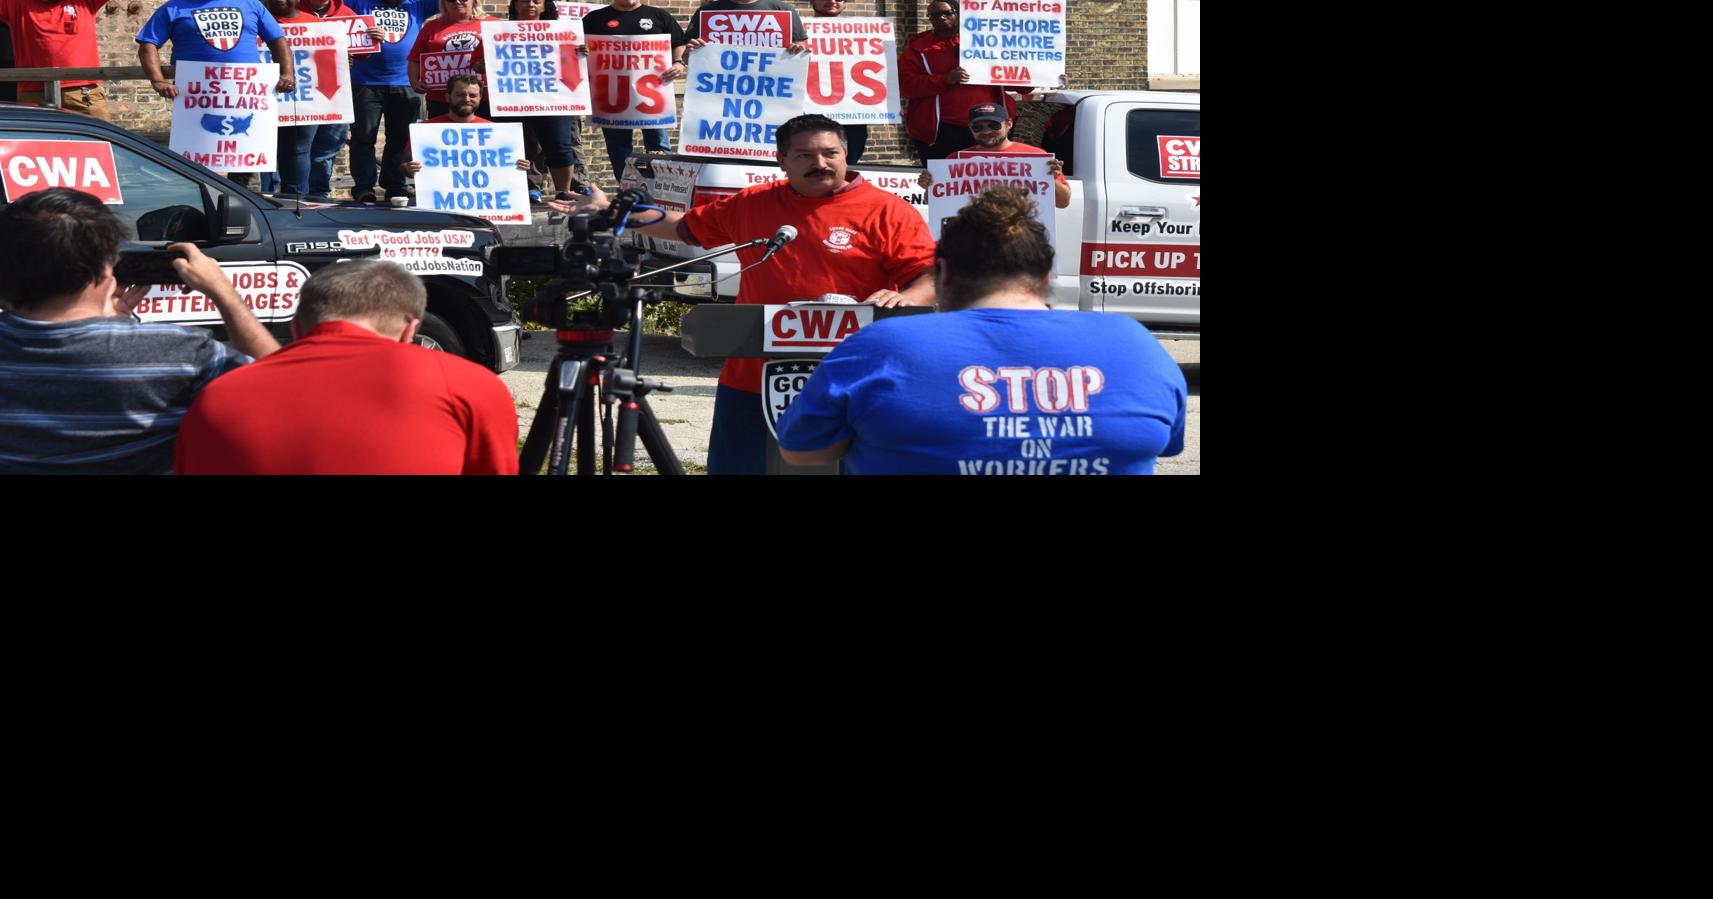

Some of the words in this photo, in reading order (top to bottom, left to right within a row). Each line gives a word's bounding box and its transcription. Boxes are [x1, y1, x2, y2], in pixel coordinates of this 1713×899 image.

[557, 5, 590, 17] EEP
[963, 0, 987, 10] for
[991, 0, 1061, 13] America
[198, 13, 238, 21] GOOD
[377, 18, 406, 27] JOBS
[708, 14, 782, 31] CWA
[964, 16, 1060, 33] OFFSHORE
[203, 21, 239, 31] JOBS
[282, 26, 308, 36] TOP
[517, 22, 550, 32] STOP
[803, 22, 891, 34] FFSHORING
[493, 32, 577, 42] OFFSHORING
[708, 31, 783, 48] STRONG
[972, 34, 998, 47] NO
[1002, 35, 1055, 49] MORE
[495, 44, 555, 60] KEEP
[590, 40, 670, 52] OFFSHORING
[807, 37, 885, 55] HURTS
[596, 54, 667, 71] HURTS
[720, 50, 776, 73] OFF
[963, 49, 998, 59] CALL
[1000, 50, 1062, 61] CENTERS
[205, 66, 257, 80] KEEP
[495, 61, 556, 76] JOBS
[990, 65, 1031, 81] CWA
[188, 81, 228, 94] U.S.
[236, 82, 268, 96] TAX
[497, 77, 558, 93] HERE
[696, 72, 795, 98] SHORE
[806, 60, 888, 106] US
[184, 95, 269, 110] DOLLARS
[595, 74, 665, 115] US
[722, 97, 763, 120] NO
[278, 114, 342, 122] OBSNATION.ORG
[441, 128, 493, 146] OFF
[699, 120, 778, 144] MORE
[217, 140, 237, 152] IN
[685, 145, 778, 157] GOODJOBSNATION.O
[422, 147, 515, 168] SHORE
[1168, 155, 1200, 170] STR
[8, 155, 111, 187] CWA
[745, 172, 777, 183] Text
[948, 161, 1032, 178] WORKER
[452, 169, 489, 189] NO
[433, 190, 511, 210] MORE
[1111, 220, 1151, 236] Keep
[1157, 221, 1193, 235] Your
[343, 234, 369, 245] Text
[415, 234, 441, 245] Jobs
[384, 248, 395, 257] to
[399, 247, 440, 258] 97779
[1090, 250, 1146, 269] PICK
[1154, 251, 1186, 269] UP
[232, 272, 278, 289] JOBS
[285, 271, 299, 288] &
[1090, 281, 1127, 296] Stop
[1132, 282, 1200, 296] Offshori
[136, 296, 216, 313] BETTER
[771, 309, 860, 339] CWA
[774, 376, 808, 392] GO
[958, 365, 1105, 414] STOP
[983, 416, 1030, 438] THE
[1037, 416, 1093, 438] WAR
[1021, 438, 1052, 458] ON
[958, 457, 1110, 475] WORKERS
